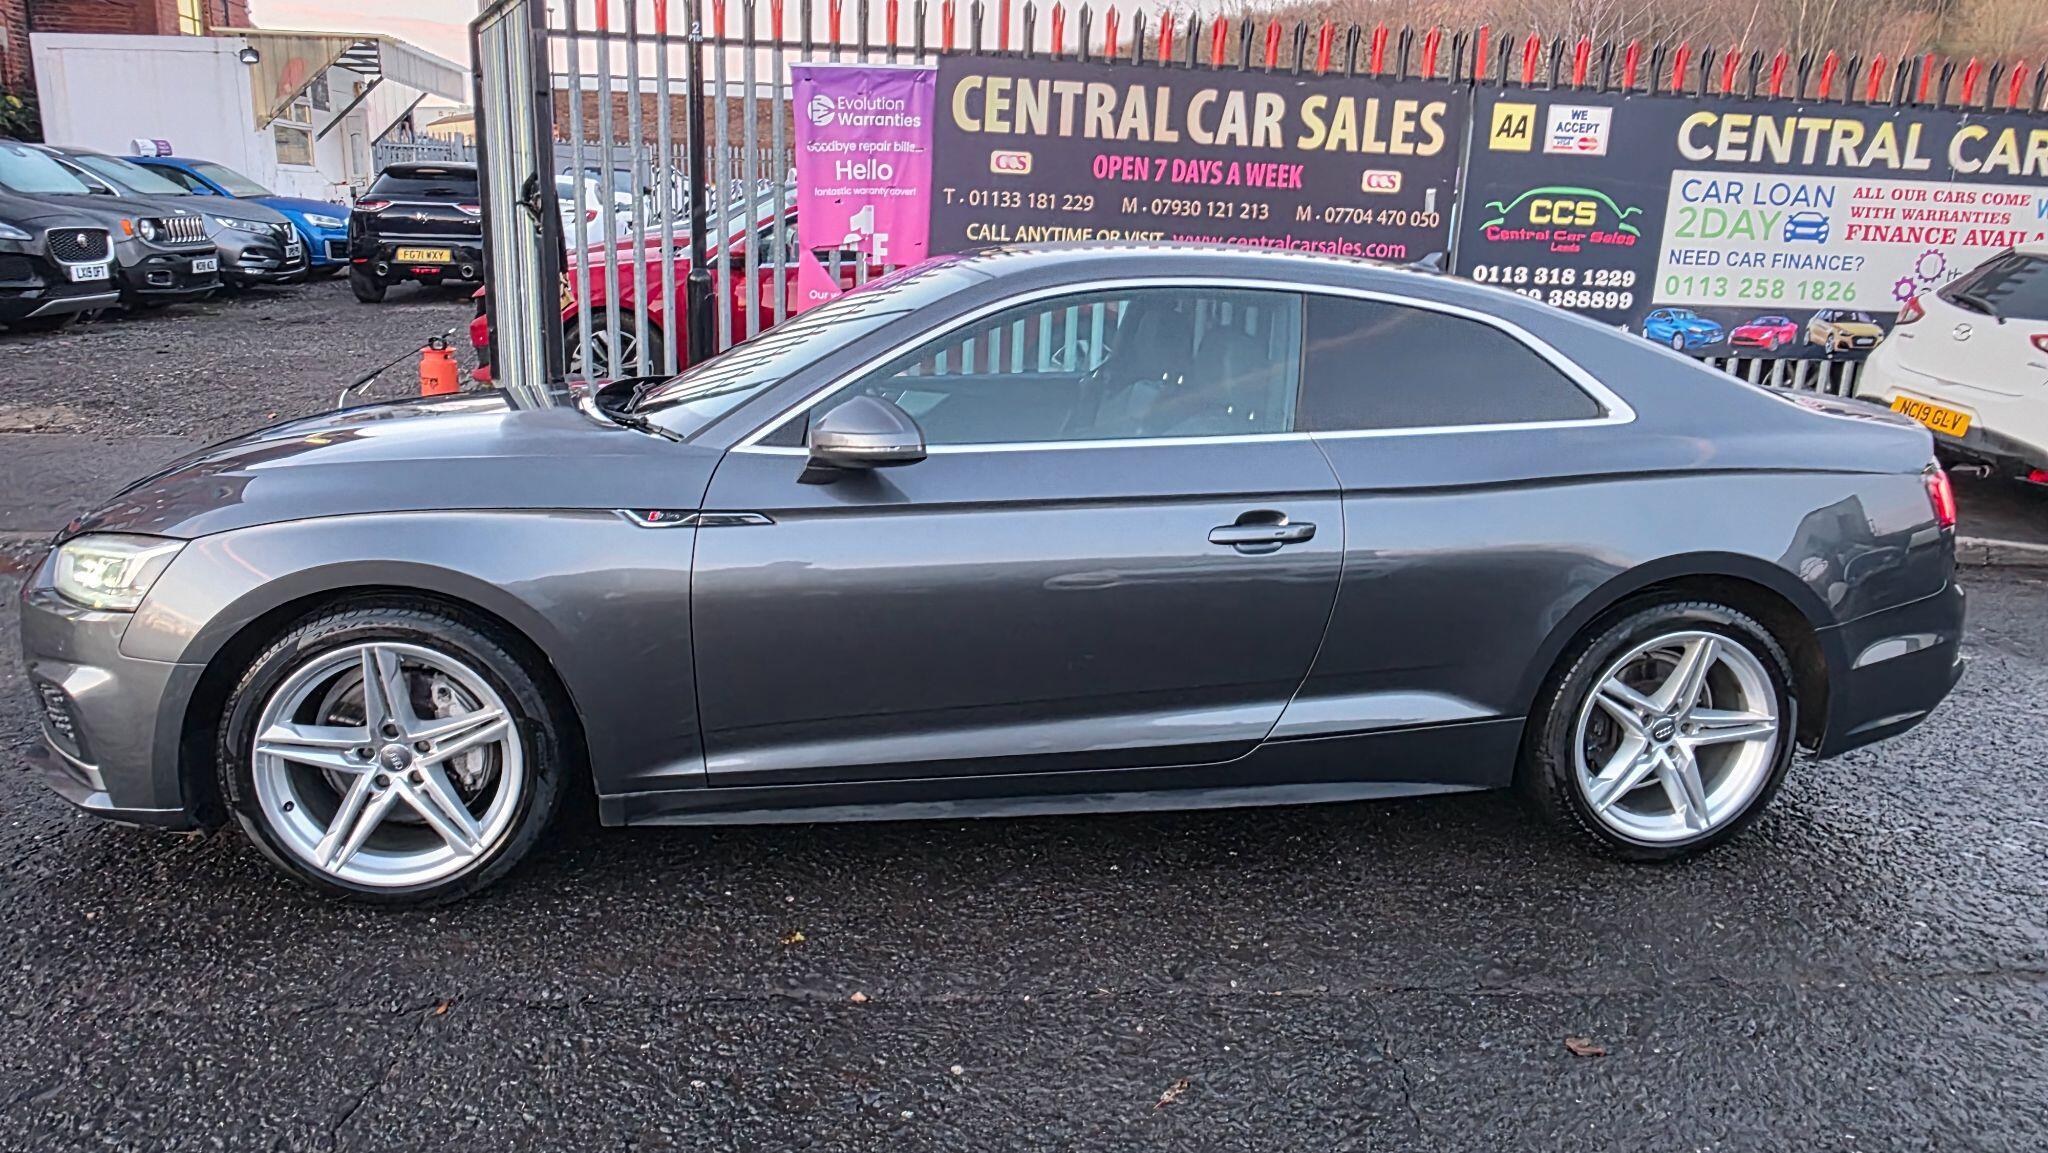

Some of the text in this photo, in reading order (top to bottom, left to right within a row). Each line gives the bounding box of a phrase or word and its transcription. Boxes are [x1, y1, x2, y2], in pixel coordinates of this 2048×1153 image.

[691, 21, 700, 34] 2
[837, 96, 905, 111] Evolution
[837, 112, 922, 128] Warranties
[952, 75, 1447, 156] CENTRAL CAR SALES
[1571, 109, 1589, 120] WE
[1495, 114, 1529, 139] AA
[1556, 122, 1600, 134] ACCEPT
[806, 141, 857, 155] Goodbye
[859, 141, 892, 154] repair
[1677, 111, 1931, 170] CENTRAL
[836, 159, 894, 181] Hello
[1093, 155, 1304, 188] OPEN 7 DAYS A WEEK
[969, 190, 1021, 208] 01133
[1028, 192, 1056, 209] 181
[1062, 194, 1094, 212] 229
[1682, 179, 1836, 208] CAR LOAN
[1852, 187, 2032, 207] ALL OUR CARS COME
[1151, 198, 1201, 217] 07930
[1207, 201, 1233, 218] 121
[1239, 203, 1269, 220] 213
[1325, 207, 1373, 225] 07704
[1377, 210, 1406, 227] 470
[1410, 211, 1440, 228] 050
[1529, 199, 1598, 226] CCS
[1850, 206, 2012, 225] WITH WARRANTIES
[966, 223, 1011, 242] CALL
[1014, 225, 1093, 243] ANYTIME
[1124, 230, 1164, 241] VISIT
[1486, 225, 1549, 242] Central
[1553, 230, 1587, 242] Car
[1674, 206, 1782, 241] 2DAY
[1845, 224, 1957, 245] FINANCE
[403, 250, 424, 260] FG71
[1669, 249, 1865, 272] NEED CAR FINANCE?
[1473, 265, 1636, 287] 0113 318 1229
[809, 289, 829, 299] Our
[1547, 289, 1633, 309] 388899
[1664, 275, 1856, 302] 0113 258 1826
[1899, 401, 1963, 431] NC19 GLV
